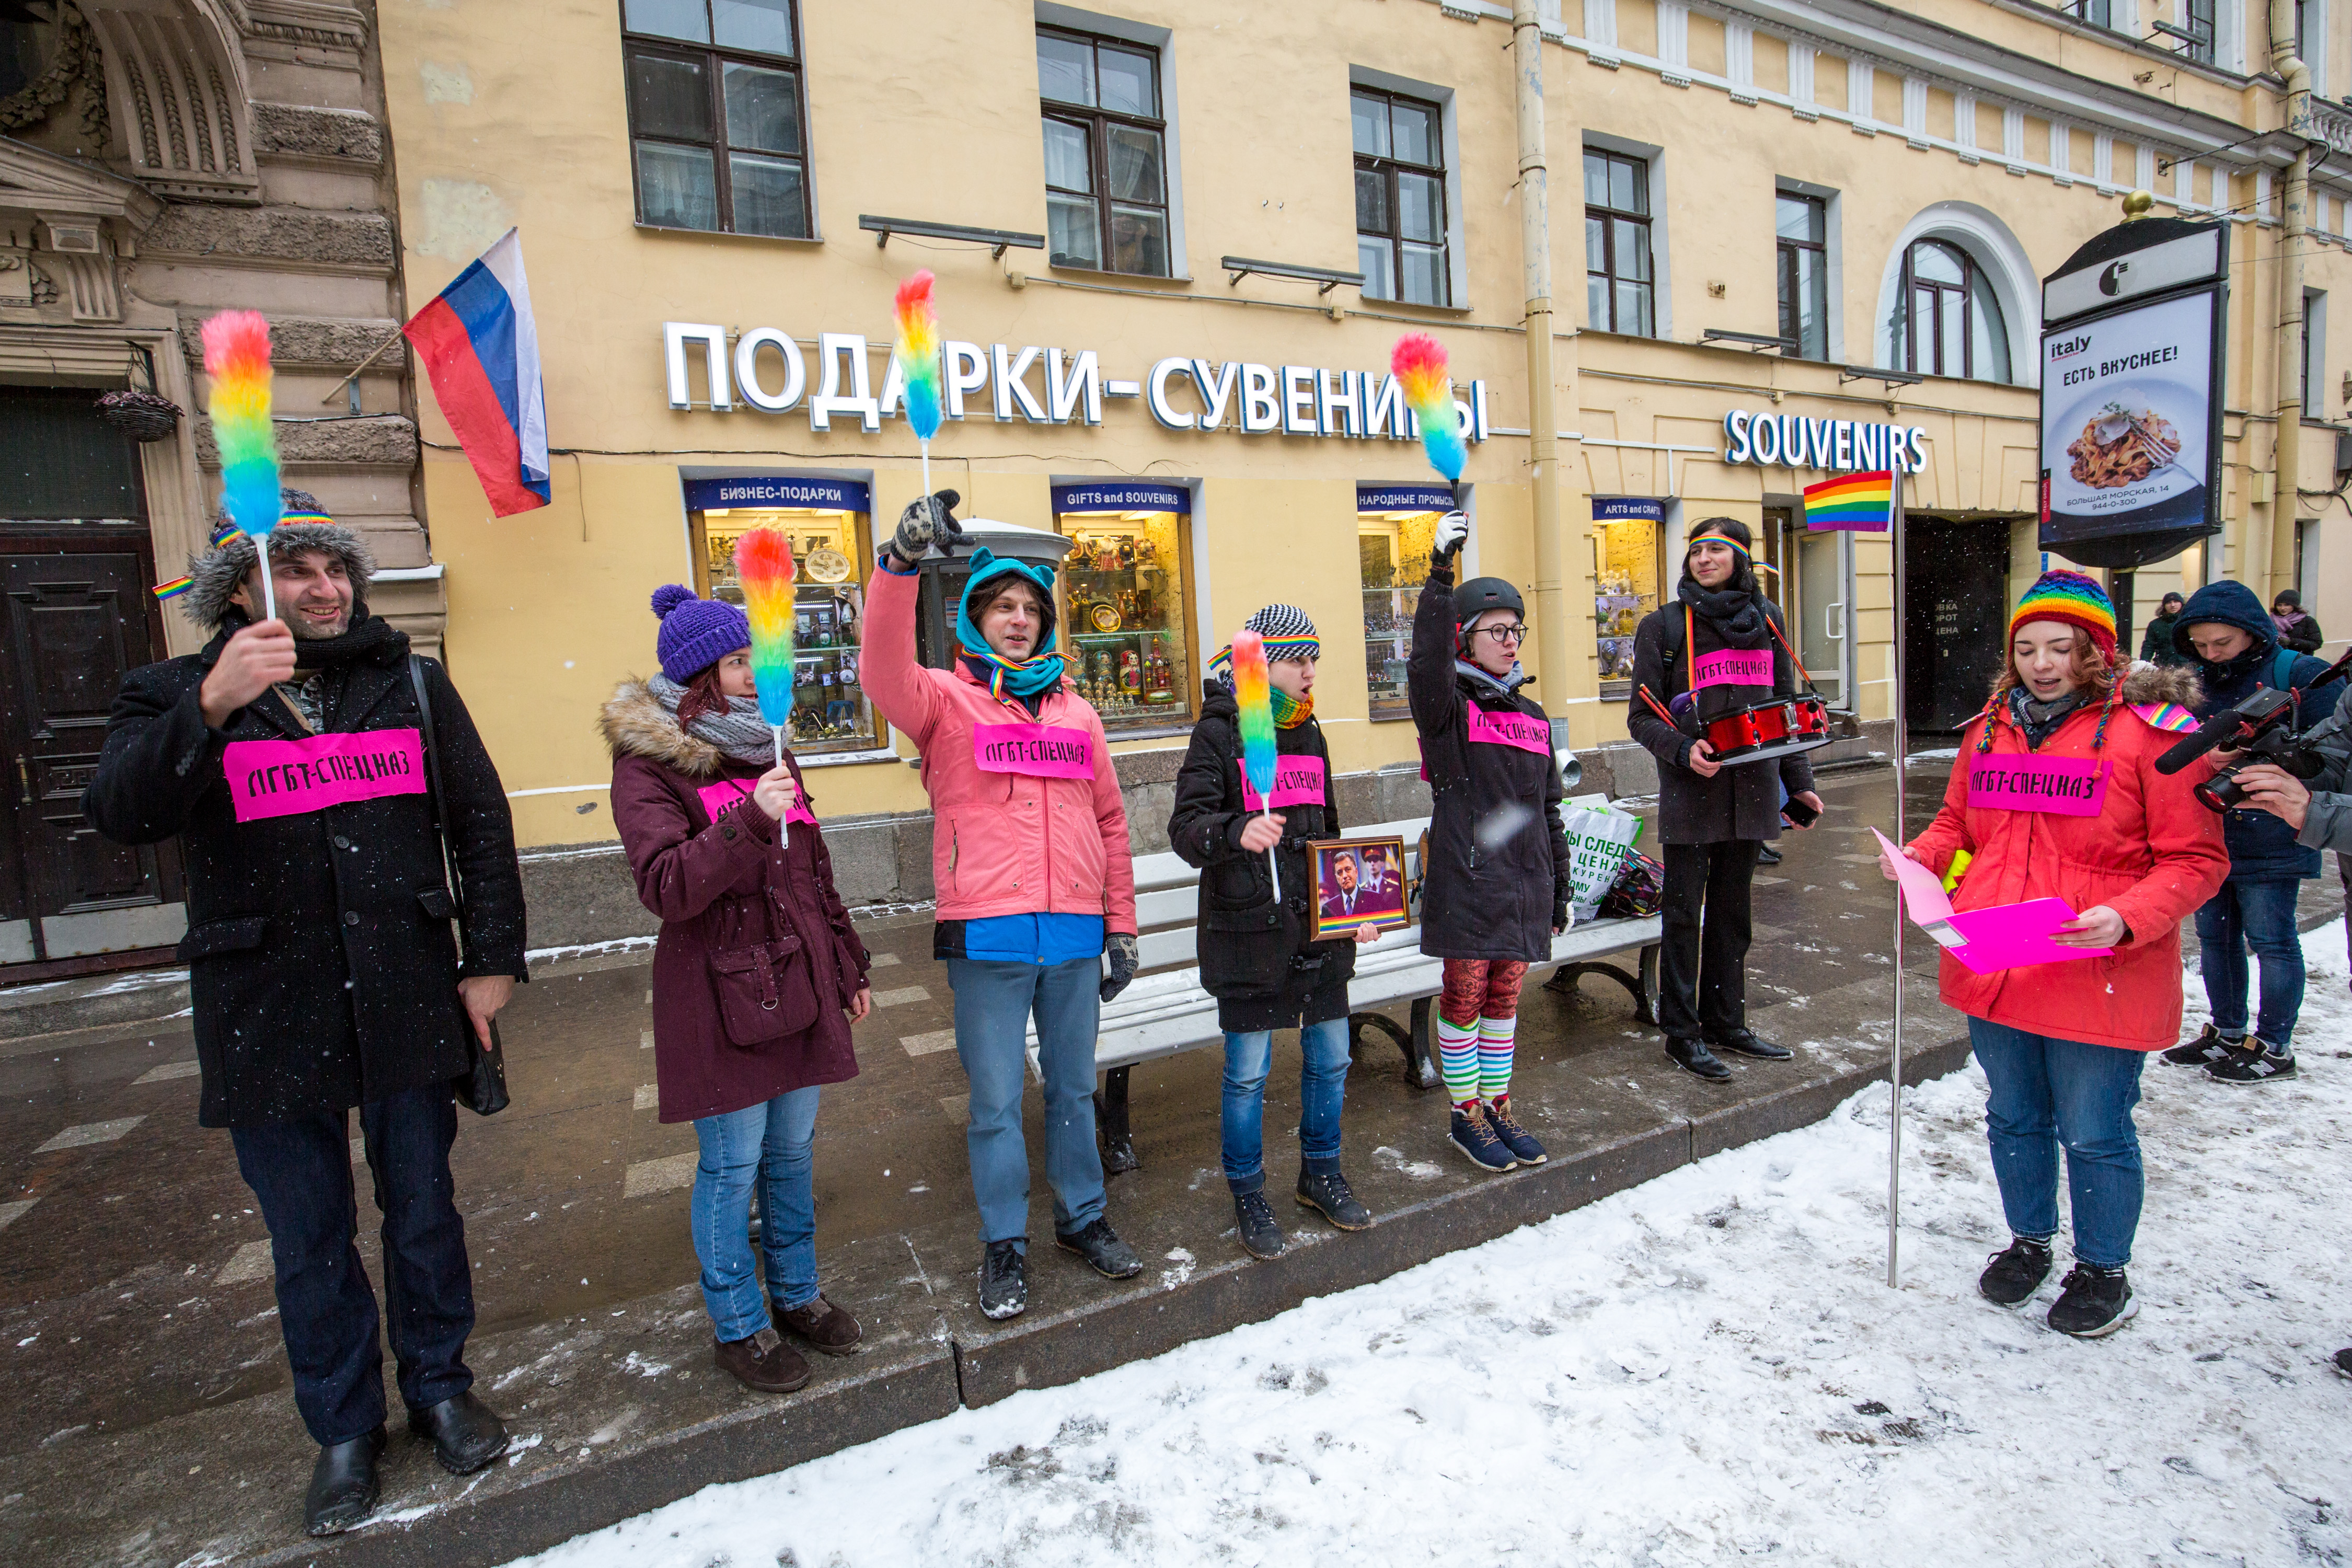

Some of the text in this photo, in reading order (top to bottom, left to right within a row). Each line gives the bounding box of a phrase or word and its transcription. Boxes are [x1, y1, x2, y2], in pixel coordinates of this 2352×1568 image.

[2051, 336, 2092, 358] italy
[2063, 345, 2177, 386] ЕСТЬ ВКУСНЕЕ!
[664, 321, 1488, 444] ПОДРКИ-СУВЕНИЫ
[1724, 409, 1927, 475] SOUVENIRS
[720, 485, 842, 502] БИЗНЕС-ПОДАРКИ
[1067, 492, 1178, 505] GIFTS and SOUVENIRS
[1359, 494, 1415, 506] НАРОДНЫЕ
[2067, 494, 2107, 506] БОЛЬШАЯ
[2109, 487, 2157, 500] МОРСКАЯ,
[2092, 498, 2137, 510] 944-0-300
[1605, 505, 1661, 515] ARTS and CRAFTS
[1477, 713, 1549, 745] ЛТ-СПЕЦНАЗ
[986, 741, 1085, 765] ЛГБТ-СПЕЦНАЗ
[247, 750, 410, 798] ЛГБТ-СПЕЦНАЗ
[1971, 770, 2095, 800] ЛГБТ-СПЕЦНАЗ
[1585, 836, 1627, 861] СЛЕД
[1578, 852, 1619, 873] ЦЕНА
[1573, 867, 1615, 883] КУРЕН
[2249, 1060, 2275, 1077] N
